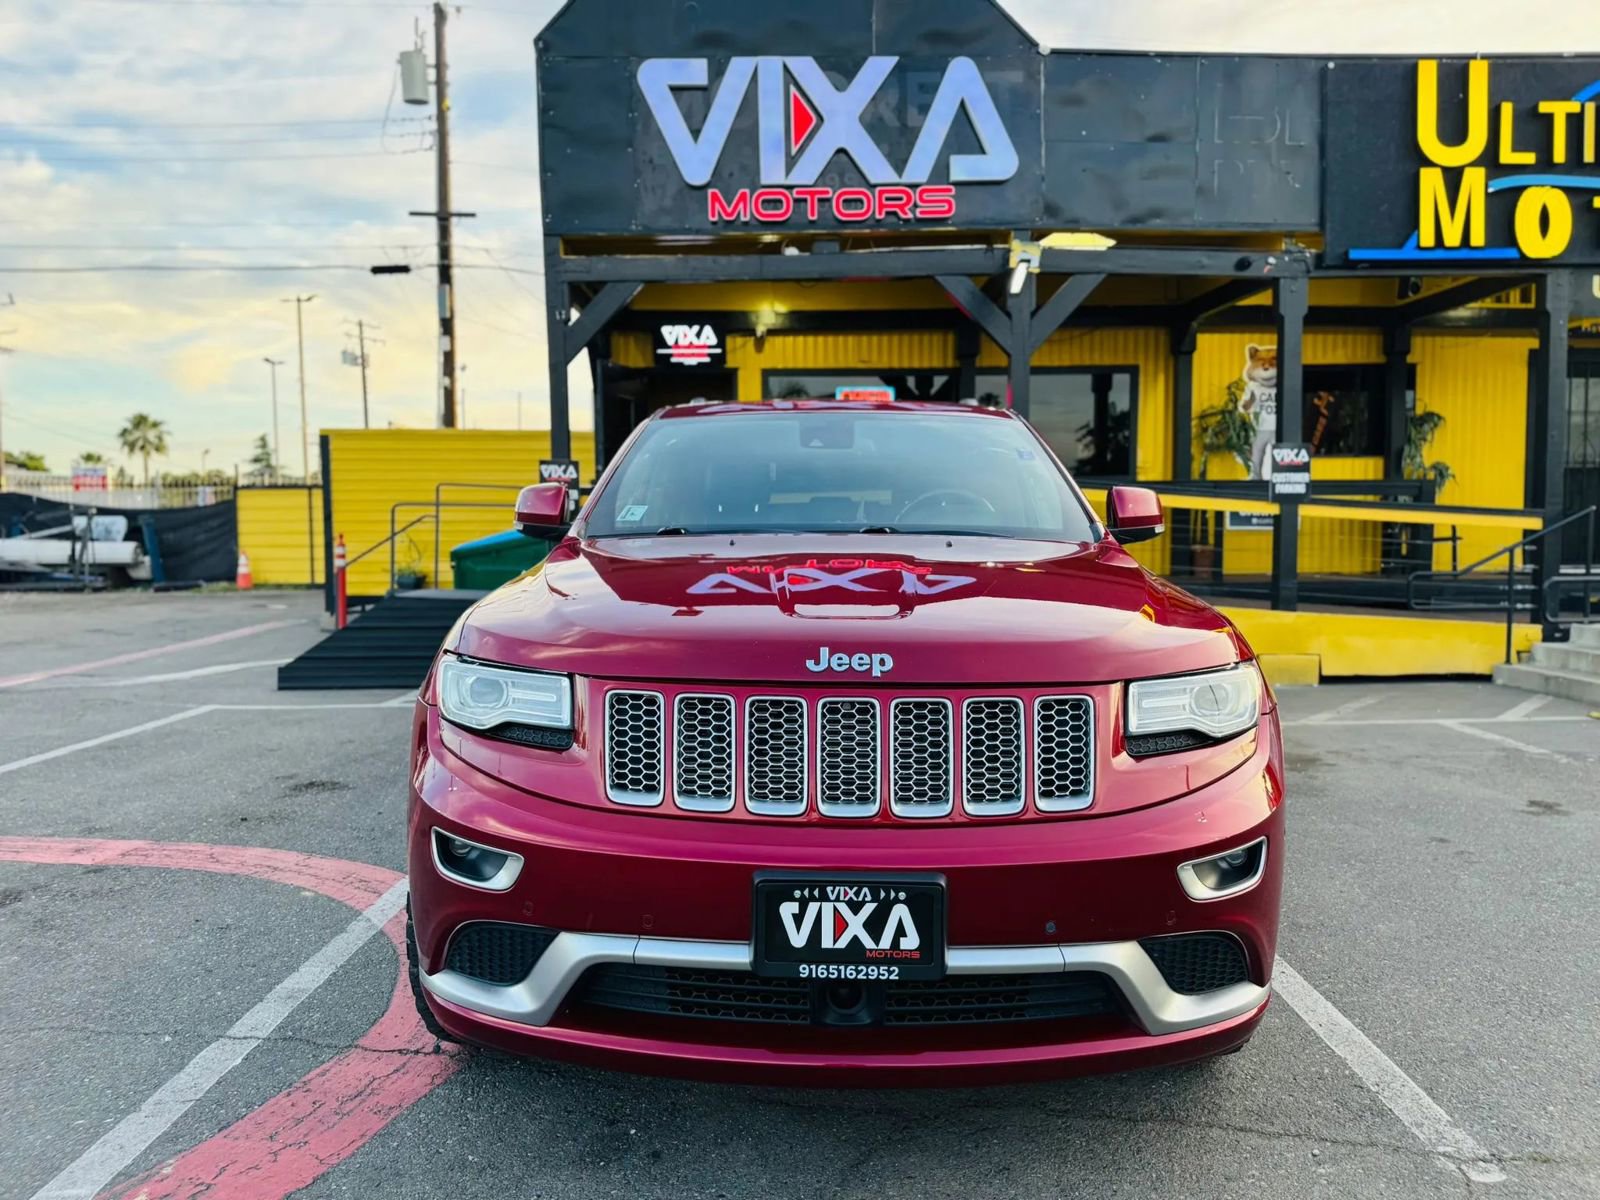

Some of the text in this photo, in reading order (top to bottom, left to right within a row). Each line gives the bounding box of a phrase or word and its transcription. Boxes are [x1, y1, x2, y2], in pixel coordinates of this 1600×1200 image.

[637, 56, 1019, 186] VIXA
[1416, 59, 1596, 168] ULTI
[708, 185, 955, 222] MOTORS
[1419, 167, 1600, 259] MO
[660, 324, 718, 346] VIXA
[1272, 448, 1310, 463] VIXA
[540, 464, 578, 479] VIXA
[805, 647, 894, 678] Jeep
[826, 886, 872, 901] VIXA
[779, 901, 920, 950] VIXA
[866, 950, 920, 959] MOTORS
[798, 964, 900, 980] 9165162952
